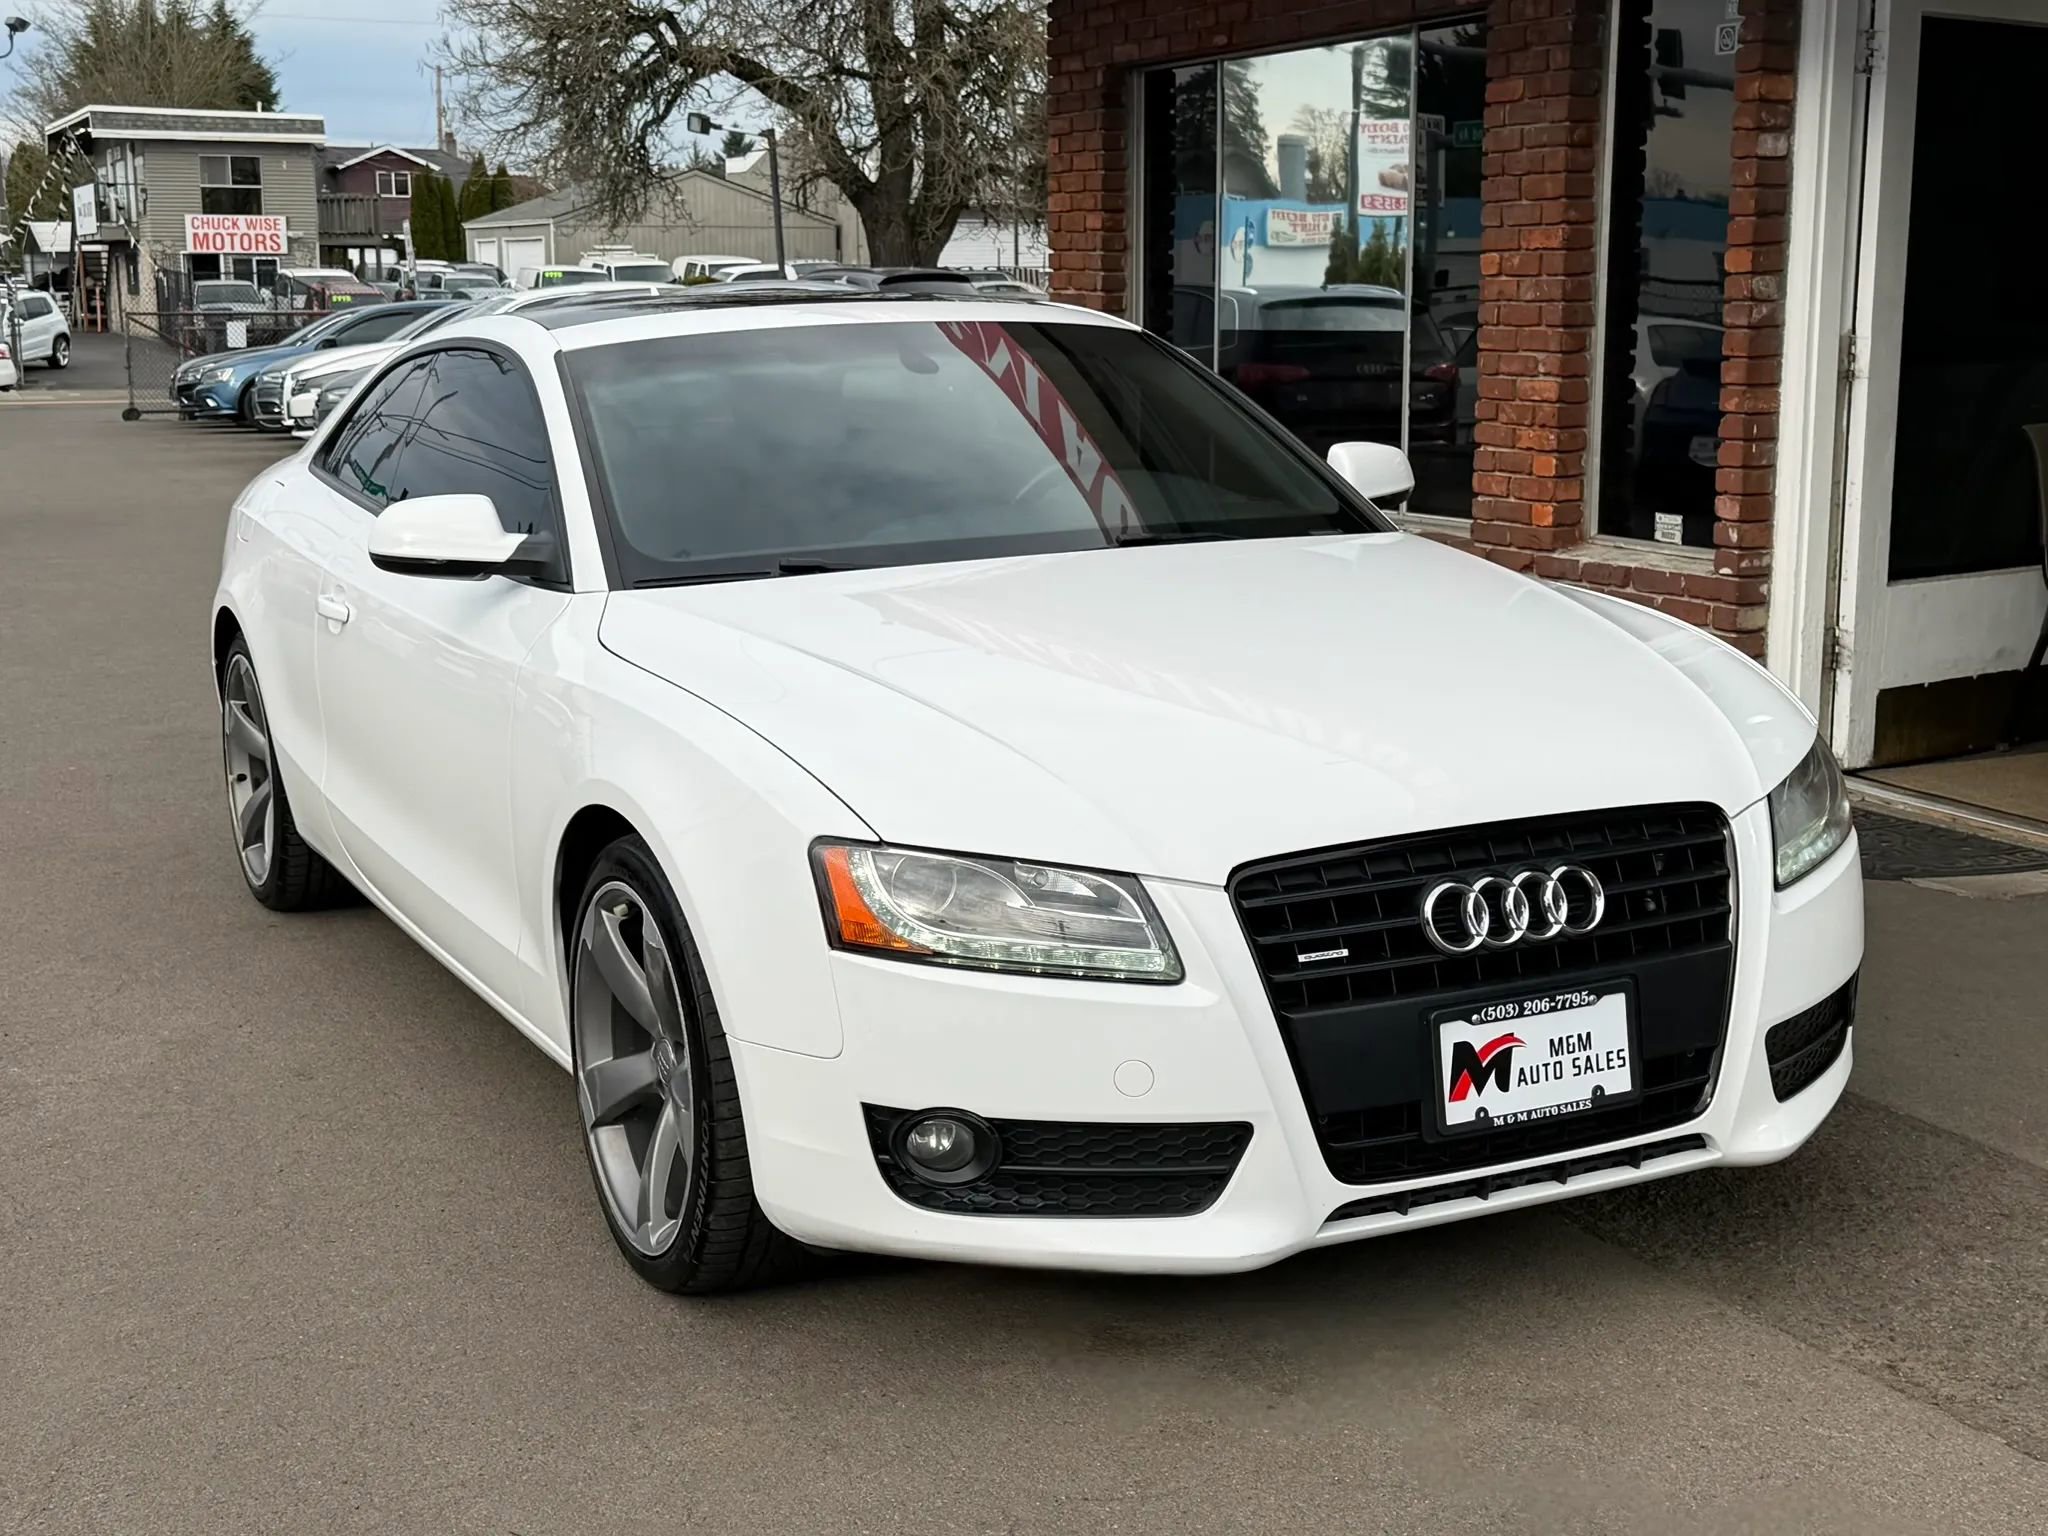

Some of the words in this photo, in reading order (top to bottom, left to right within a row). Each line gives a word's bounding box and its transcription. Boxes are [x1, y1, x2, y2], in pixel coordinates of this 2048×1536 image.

[191, 216, 240, 230] CHUCK
[245, 218, 282, 231] WISE
[192, 232, 282, 252] MOTORS
[1481, 1003, 1519, 1022] (503)
[1523, 990, 1590, 1016] 206-7795
[1549, 1031, 1593, 1058] M&M
[1517, 1060, 1563, 1088] AUTO
[1572, 1048, 1627, 1077] SALES
[1493, 1116, 1504, 1127] M
[1516, 1112, 1529, 1122] M
[1530, 1107, 1558, 1120] AUTO
[1560, 1099, 1593, 1114] SALES
